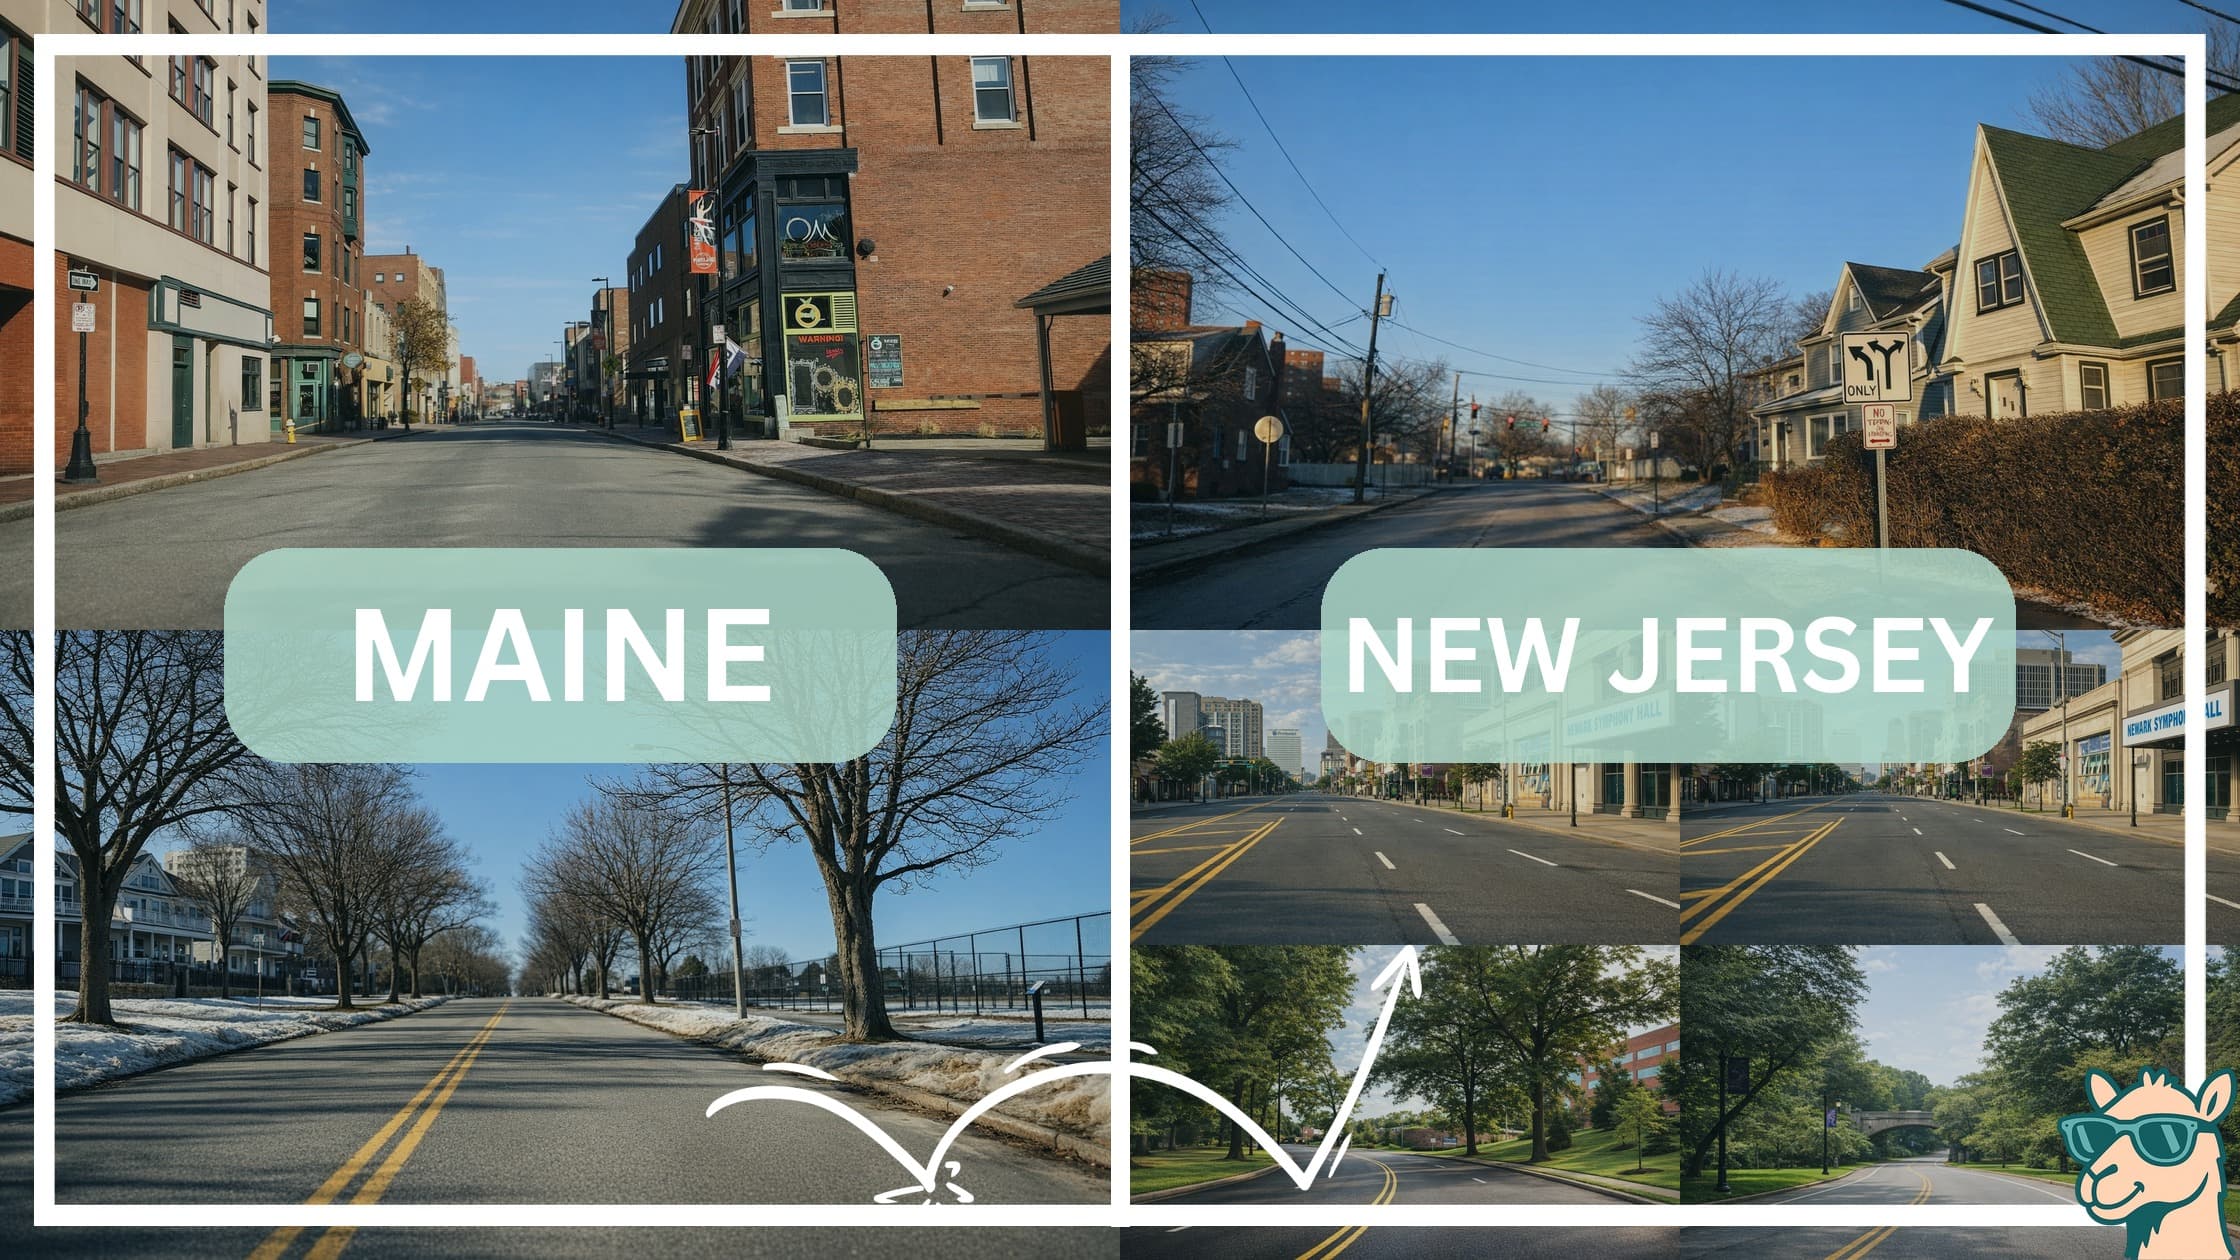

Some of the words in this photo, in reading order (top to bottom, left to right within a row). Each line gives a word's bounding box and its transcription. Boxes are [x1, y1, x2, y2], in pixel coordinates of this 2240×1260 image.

[1847, 385, 1877, 396] ONLY
[1873, 408, 1885, 418] NO
[1637, 699, 1662, 721] HALL
[2127, 719, 2152, 737] NEWARK
[2154, 709, 2185, 732] SYMPHO
[2205, 700, 2222, 719] ALL
